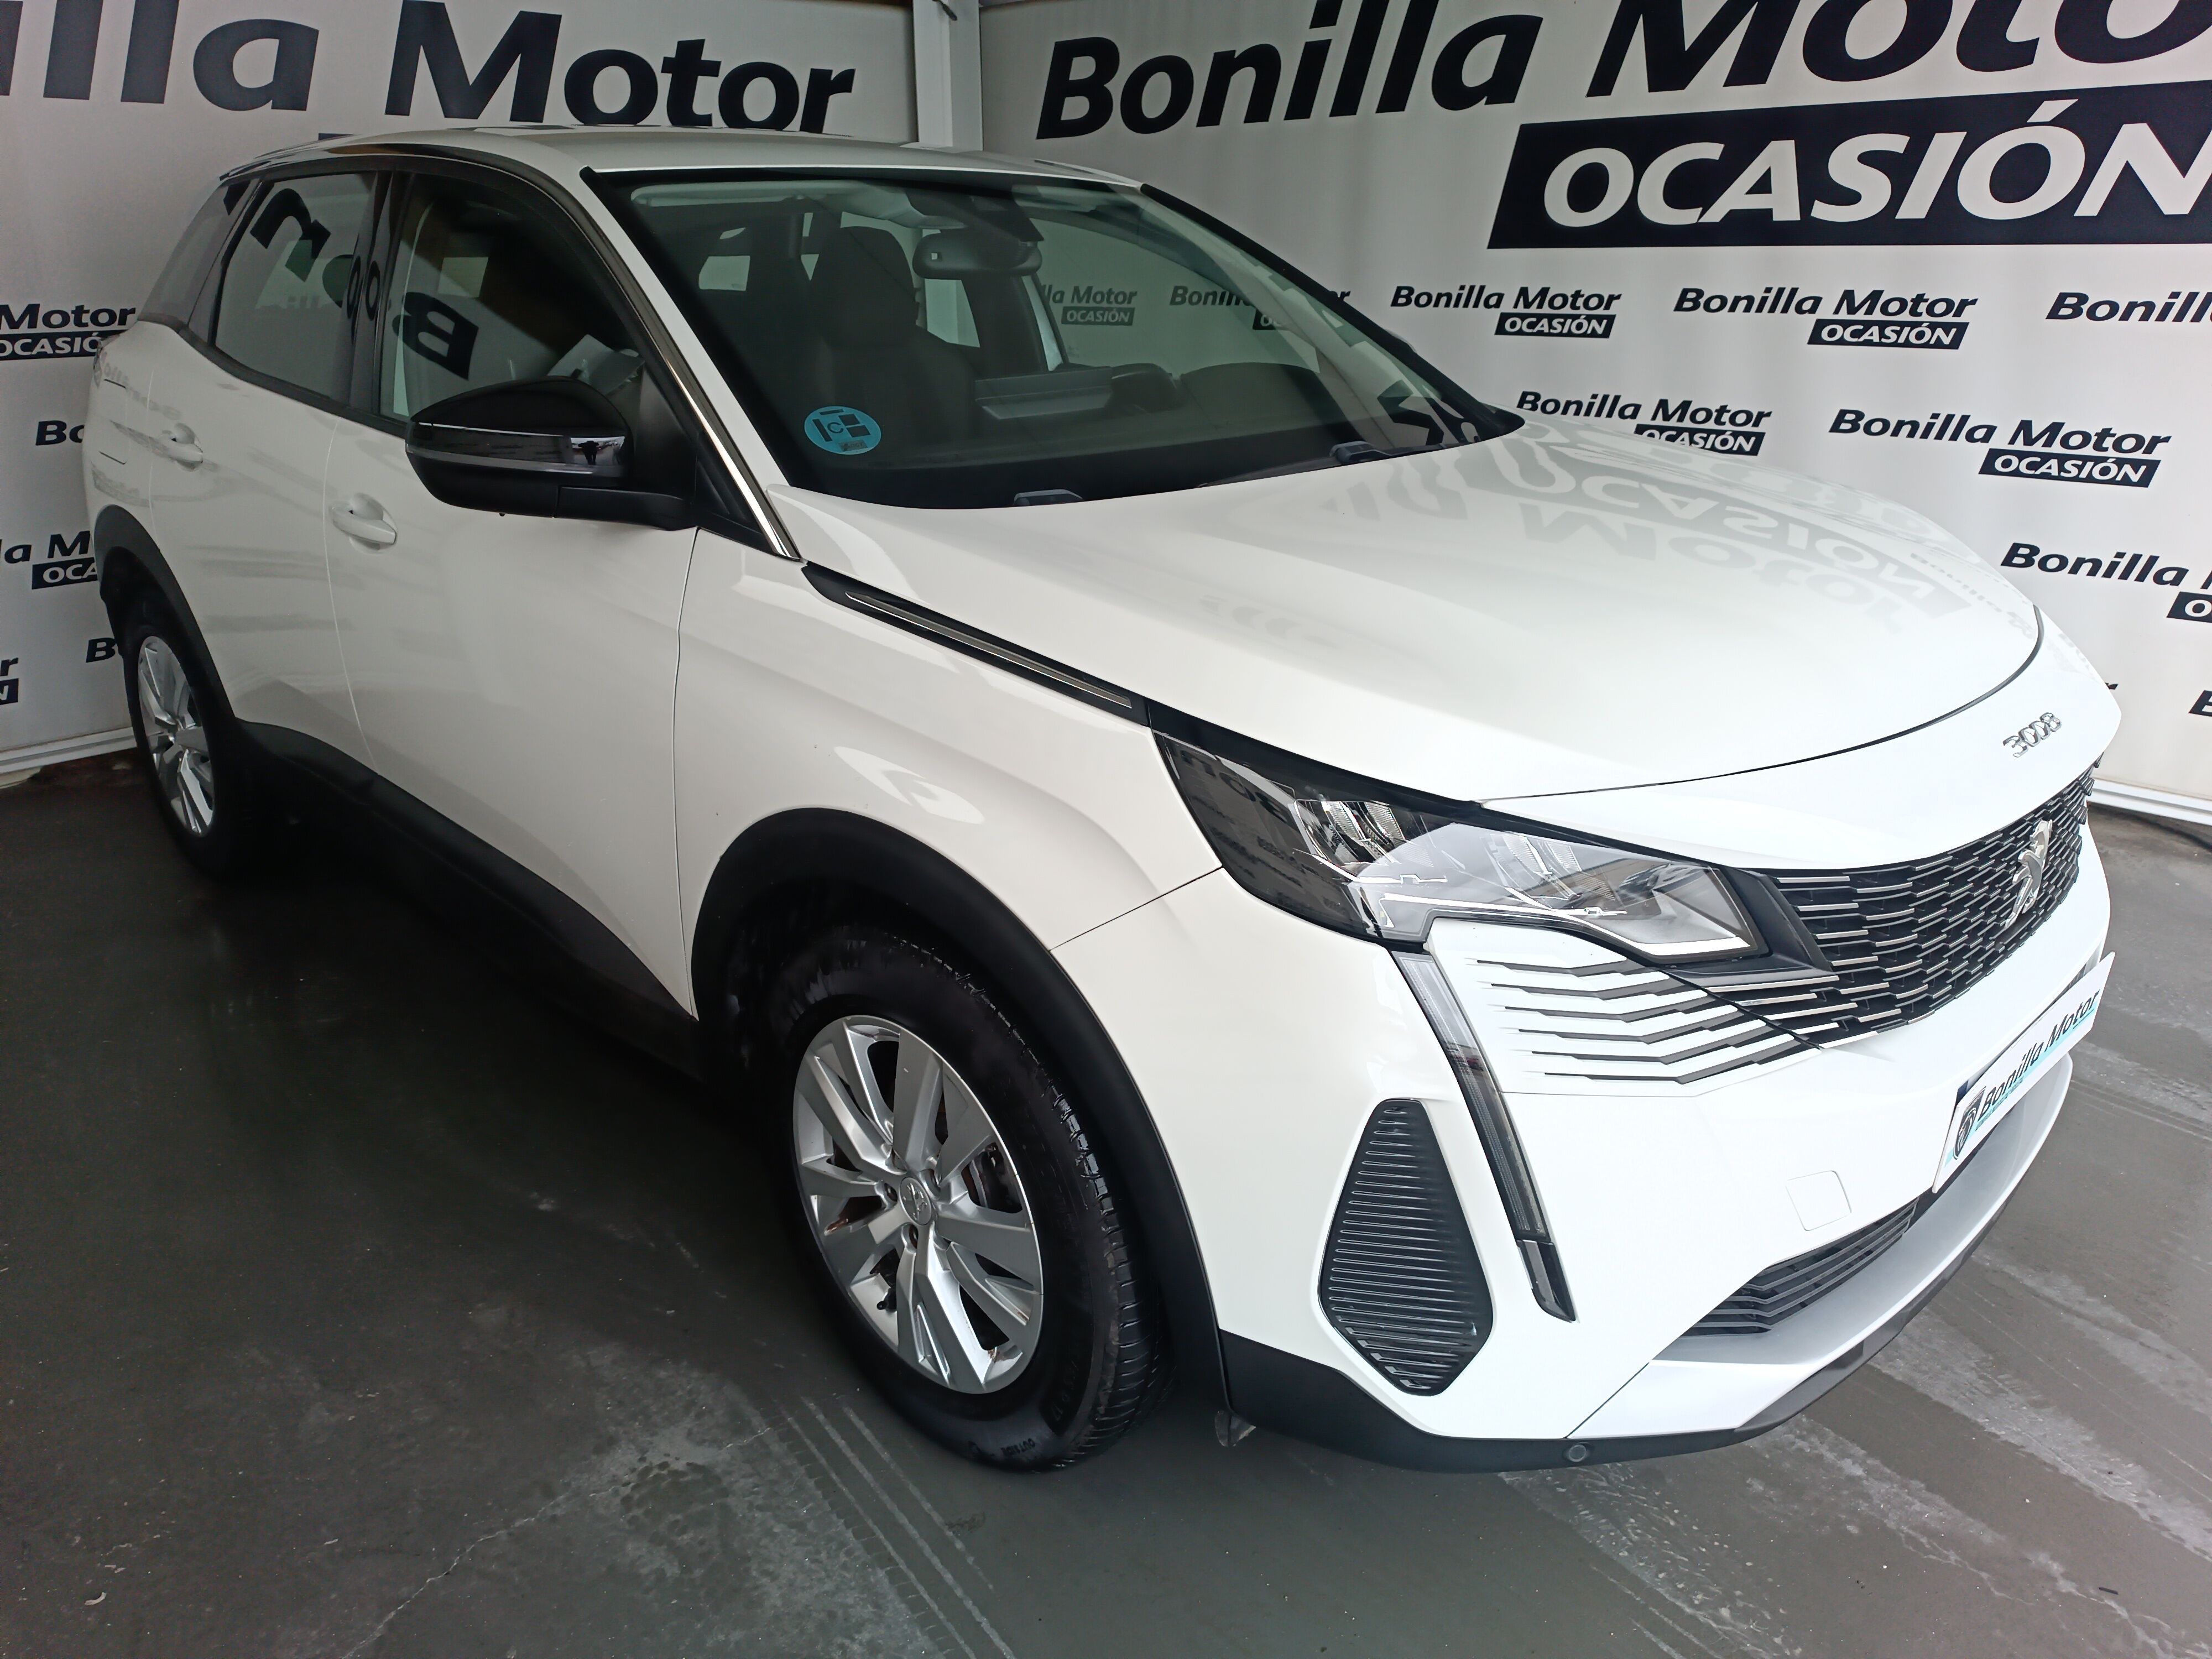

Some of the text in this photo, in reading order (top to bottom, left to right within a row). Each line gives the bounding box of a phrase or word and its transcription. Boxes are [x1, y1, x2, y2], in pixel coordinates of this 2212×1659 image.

[0, 0, 855, 133] lla Motor
[1036, 0, 1543, 139] Bonilla
[1544, 99, 2212, 227] OCASIÓN
[1071, 285, 1138, 305] Motor
[1391, 285, 1621, 311] Bonilla Motor
[1673, 287, 1978, 317] Bonilla Motor
[2046, 291, 2212, 322] Bonill
[0, 304, 136, 330] Motor
[1067, 309, 1130, 322] OCASIÓN
[1505, 315, 1607, 334] OCASIÓN
[0, 332, 101, 357] OCASIÓ
[1820, 322, 1957, 345] OCASIÓN
[1516, 391, 1772, 428] Bonilla Motor
[827, 422, 843, 434] C
[1829, 409, 2172, 455] Bonilla Motor
[1994, 455, 2146, 482] OCASIÓN
[2001, 542, 2189, 586] Bonilla
[2002, 712, 2062, 758] 3008
[1978, 1042, 2044, 1121] Bonilla
[2044, 989, 2100, 1052] Motor
